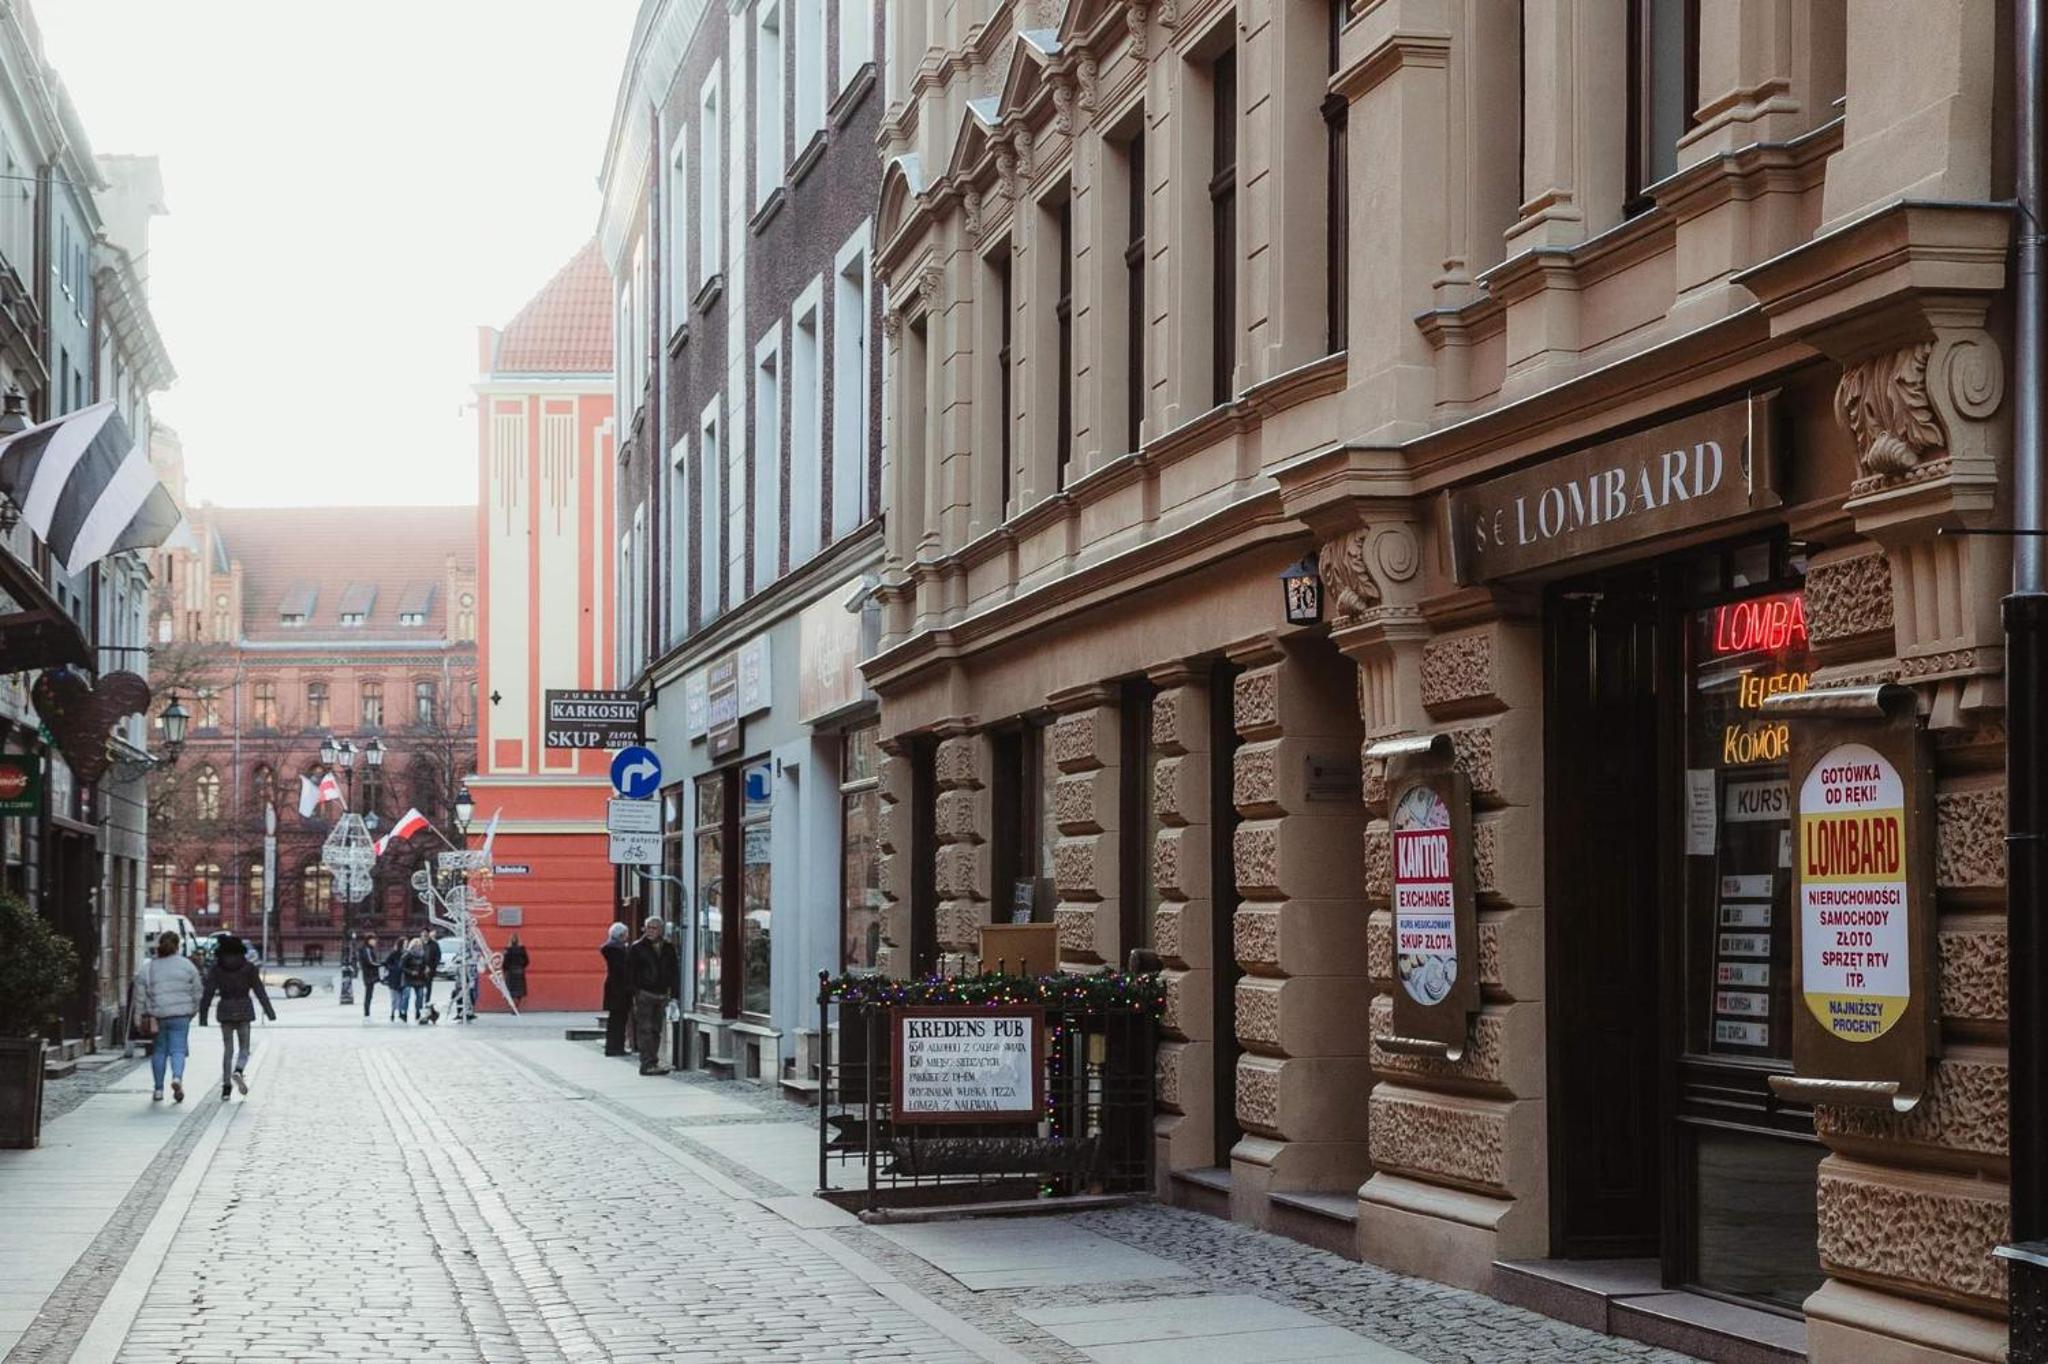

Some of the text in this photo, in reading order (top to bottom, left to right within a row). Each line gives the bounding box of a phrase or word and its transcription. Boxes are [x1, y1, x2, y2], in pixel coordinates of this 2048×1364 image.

[1515, 440, 1723, 546] LOMBARD
[1718, 596, 1807, 651] LOMBA
[563, 692, 627, 700] JUBILER
[554, 704, 636, 719] KARKOSIK
[547, 731, 600, 747] SKUP
[1821, 762, 1881, 785] GOTÓWKA
[1825, 785, 1878, 807] OD RĘKI!
[1807, 817, 1900, 877] LOMBARD
[1398, 835, 1450, 879] KANTOR
[1400, 890, 1451, 908] EXCHANGE
[1809, 885, 1901, 905] NIERUCHOMOŚCI
[1819, 910, 1890, 926] SAMOCHODY
[1401, 934, 1452, 950] SKUP ZŁOTA
[1836, 931, 1873, 946] ZŁOTO
[1822, 951, 1889, 970] SPRZĘT RTV
[1846, 973, 1866, 988] ITP.
[1829, 999, 1884, 1017] NAJNIŻSZY
[908, 1020, 1025, 1038] KREDENS PUB
[1833, 1018, 1882, 1034] PROCENT!
